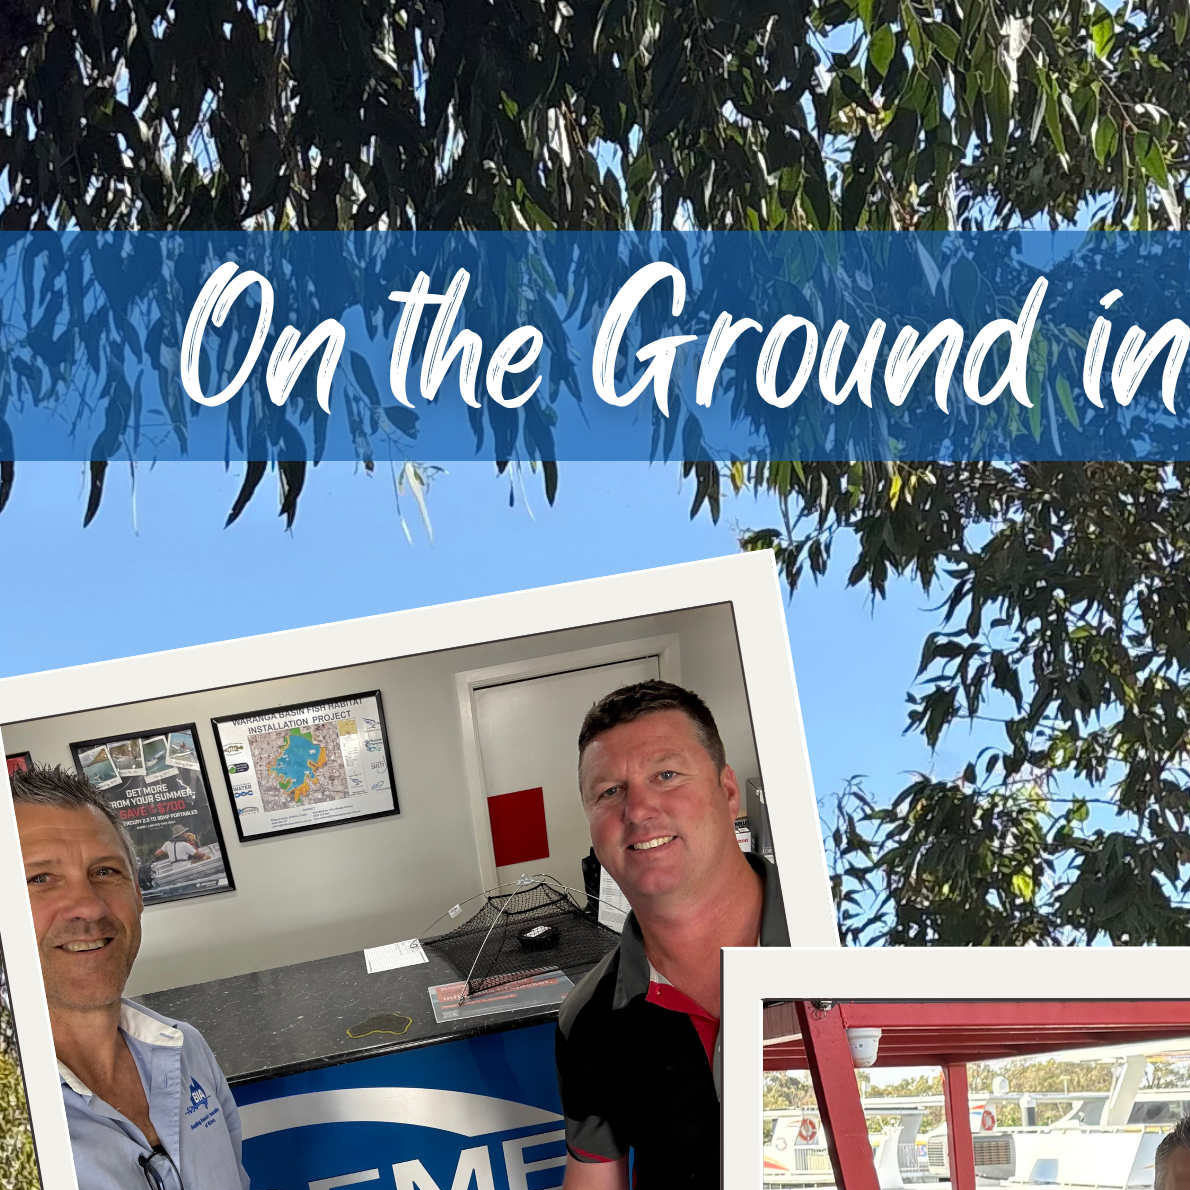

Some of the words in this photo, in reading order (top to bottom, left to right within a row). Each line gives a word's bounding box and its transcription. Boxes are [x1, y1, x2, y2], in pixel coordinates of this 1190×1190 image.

[247, 719, 309, 735] INSTALLATION
[312, 710, 351, 724] PROJECT
[126, 787, 142, 798] GET
[143, 783, 169, 795] MORE
[233, 784, 252, 792] WATER
[109, 799, 131, 810] ROM
[131, 795, 155, 806] YOUR
[119, 806, 148, 820] SAVE
[157, 800, 186, 814] $700
[192, 1089, 206, 1103] BIA
